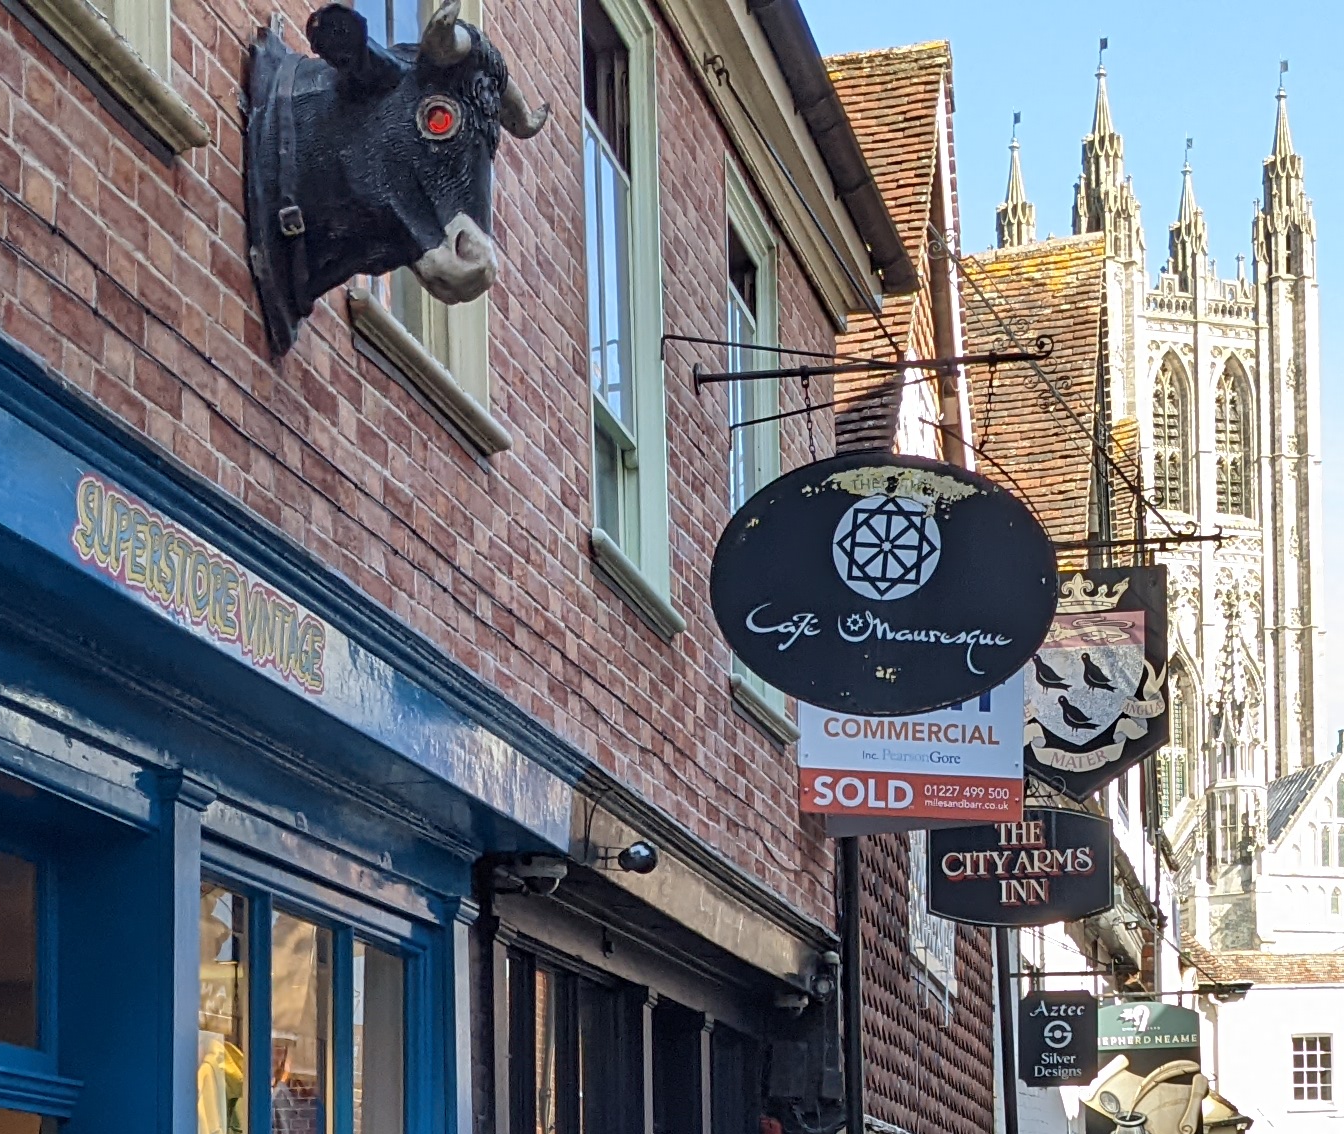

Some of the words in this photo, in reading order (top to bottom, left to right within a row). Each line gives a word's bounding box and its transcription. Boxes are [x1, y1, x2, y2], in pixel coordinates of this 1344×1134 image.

[74, 476, 240, 638] SUPERSTORE
[238, 577, 325, 689] VINTAGE
[823, 716, 1001, 745] COMMERCIAL
[1051, 750, 1108, 769] MATER
[813, 775, 914, 809] SOLD
[924, 784, 960, 797] 01227
[963, 786, 985, 799] 499
[988, 787, 1010, 800] 500
[924, 799, 1009, 811] milesandbarr.co.uk
[994, 819, 1045, 847] THE
[941, 850, 1012, 880] CITY
[1012, 847, 1095, 874] ARMS
[999, 878, 1050, 904] INN
[1029, 1000, 1086, 1017] Aztec
[1155, 1034, 1197, 1043] NEAME
[1040, 1052, 1076, 1065] Silver
[1034, 1065, 1082, 1080] Designs
